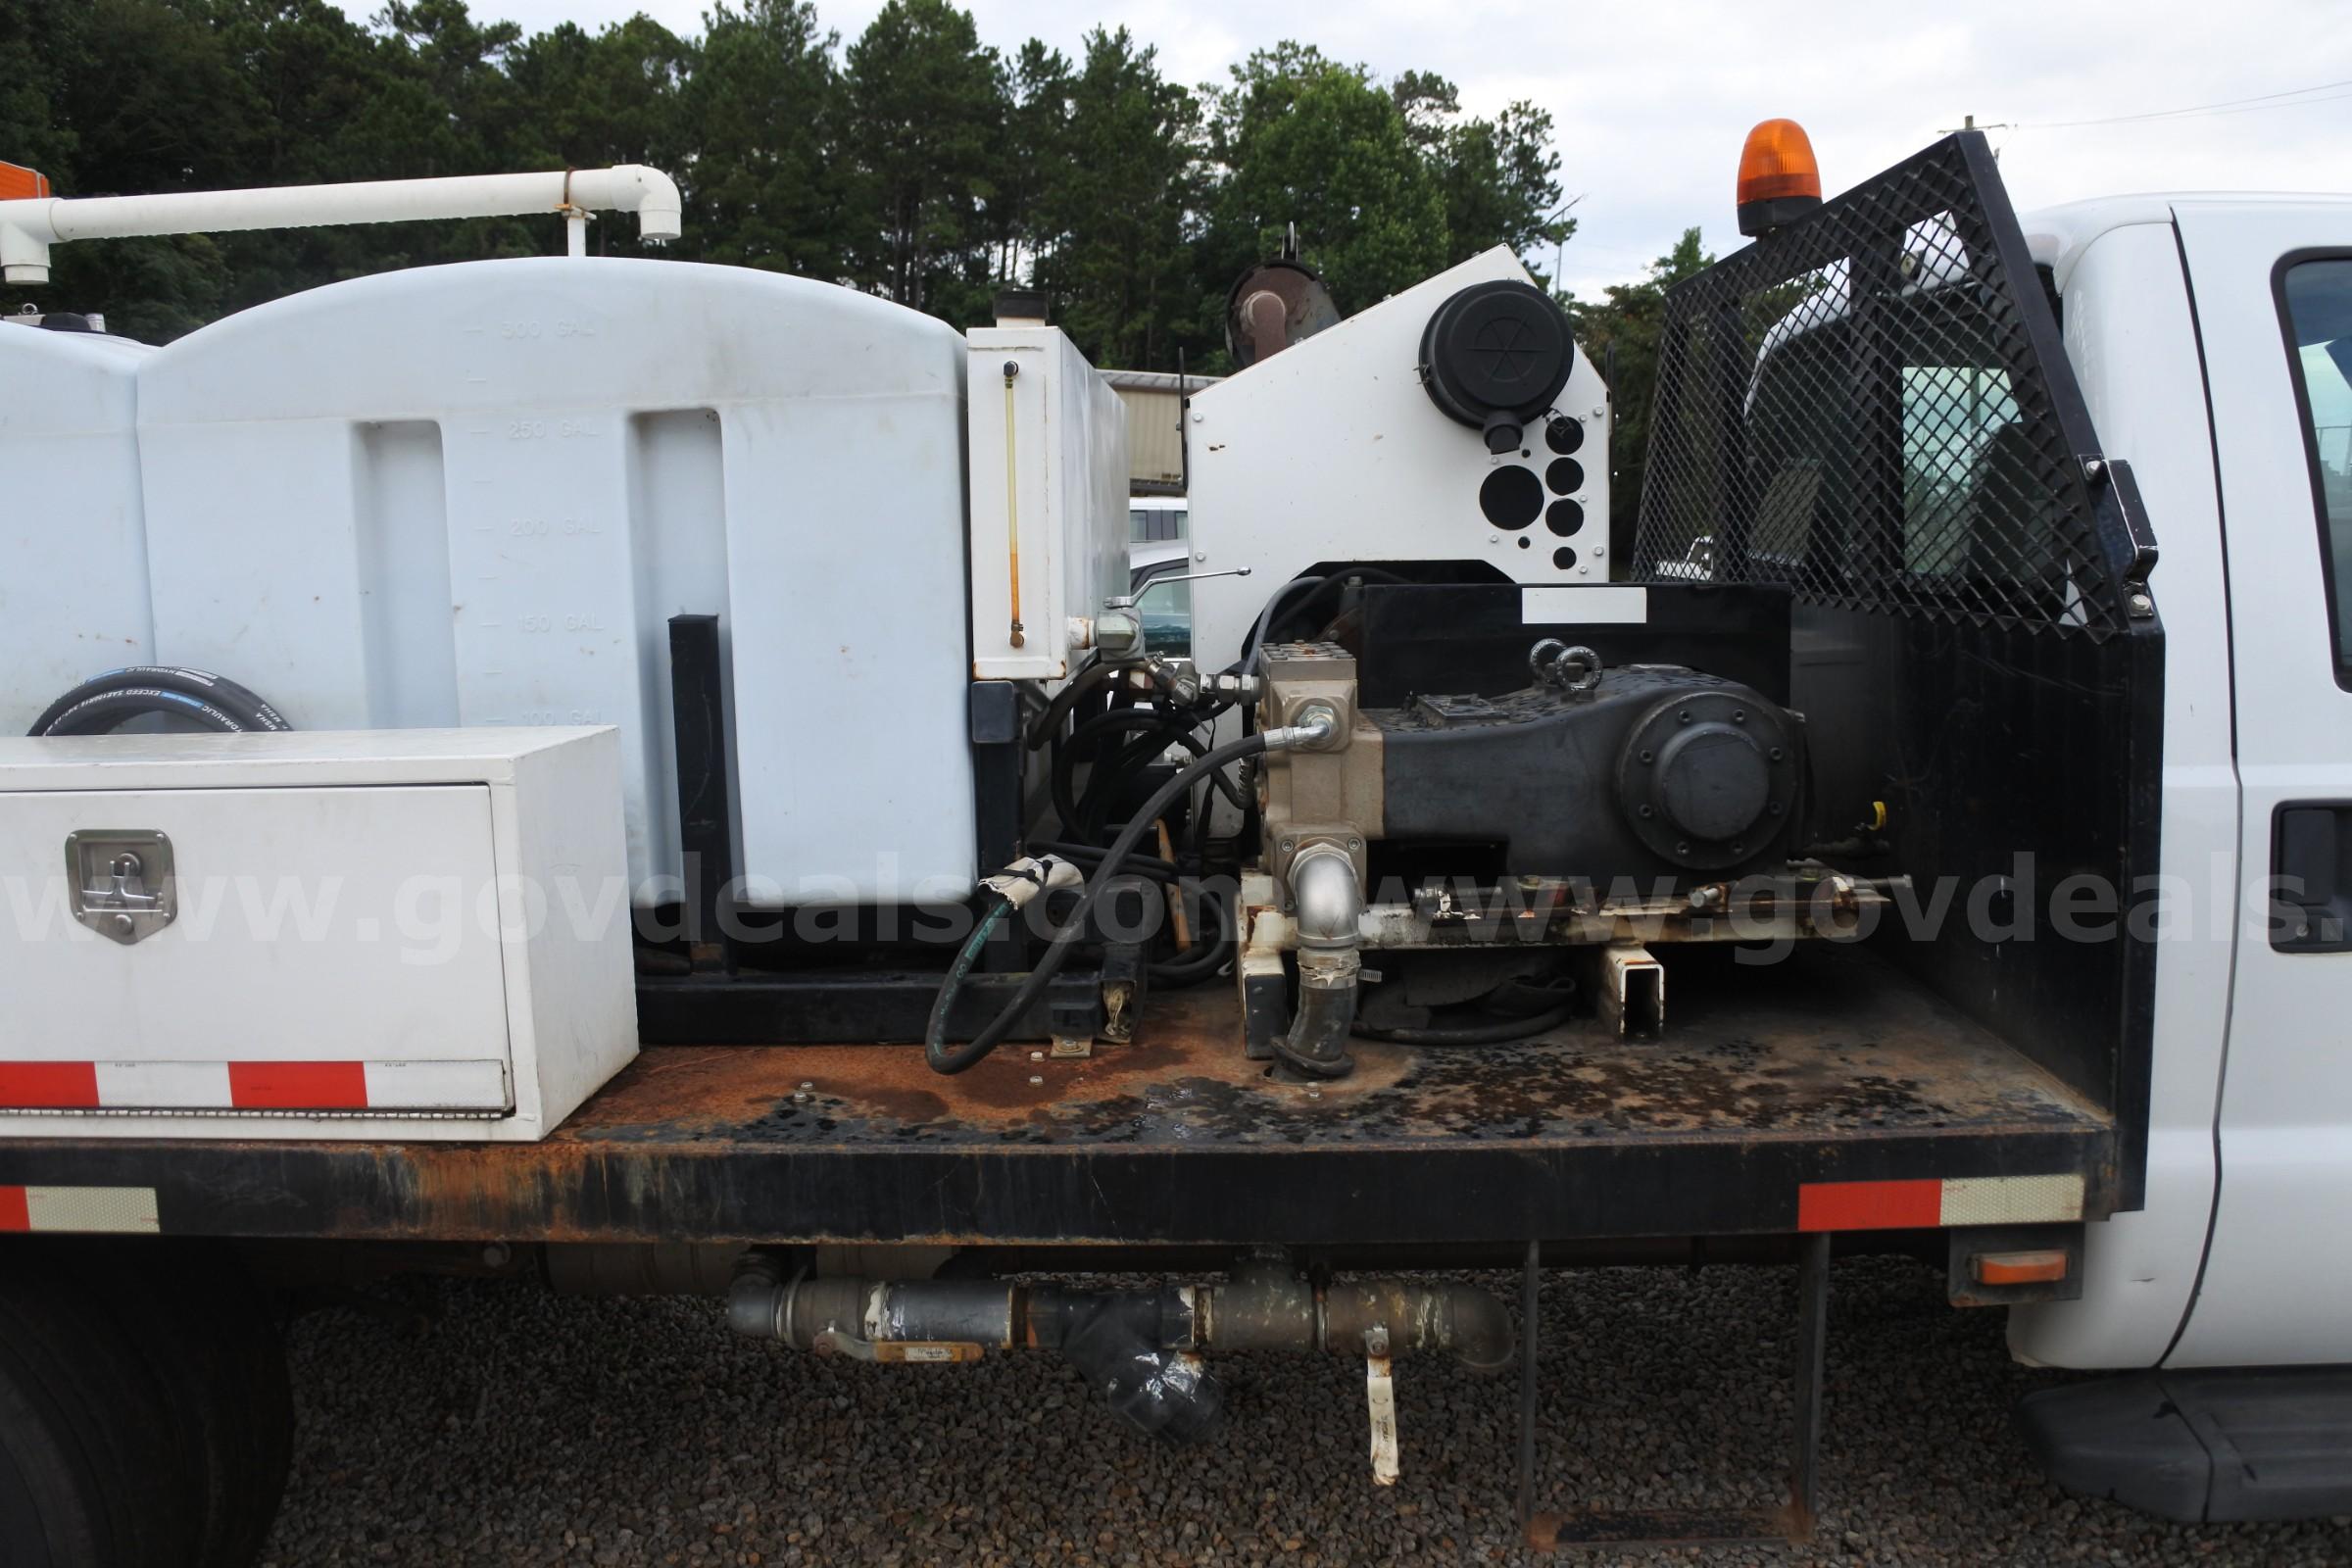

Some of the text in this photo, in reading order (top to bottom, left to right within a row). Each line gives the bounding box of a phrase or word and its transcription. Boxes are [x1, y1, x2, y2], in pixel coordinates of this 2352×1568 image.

[555, 318, 596, 337] GAL
[509, 417, 604, 440] 250 GAL
[510, 514, 604, 536] 200 GAL
[517, 611, 605, 632] 150 GAL
[125, 689, 162, 698] EXCEED
[200, 706, 243, 734] YDRAULIC
[255, 712, 276, 731] MSHA
[259, 703, 282, 722] MSHA
